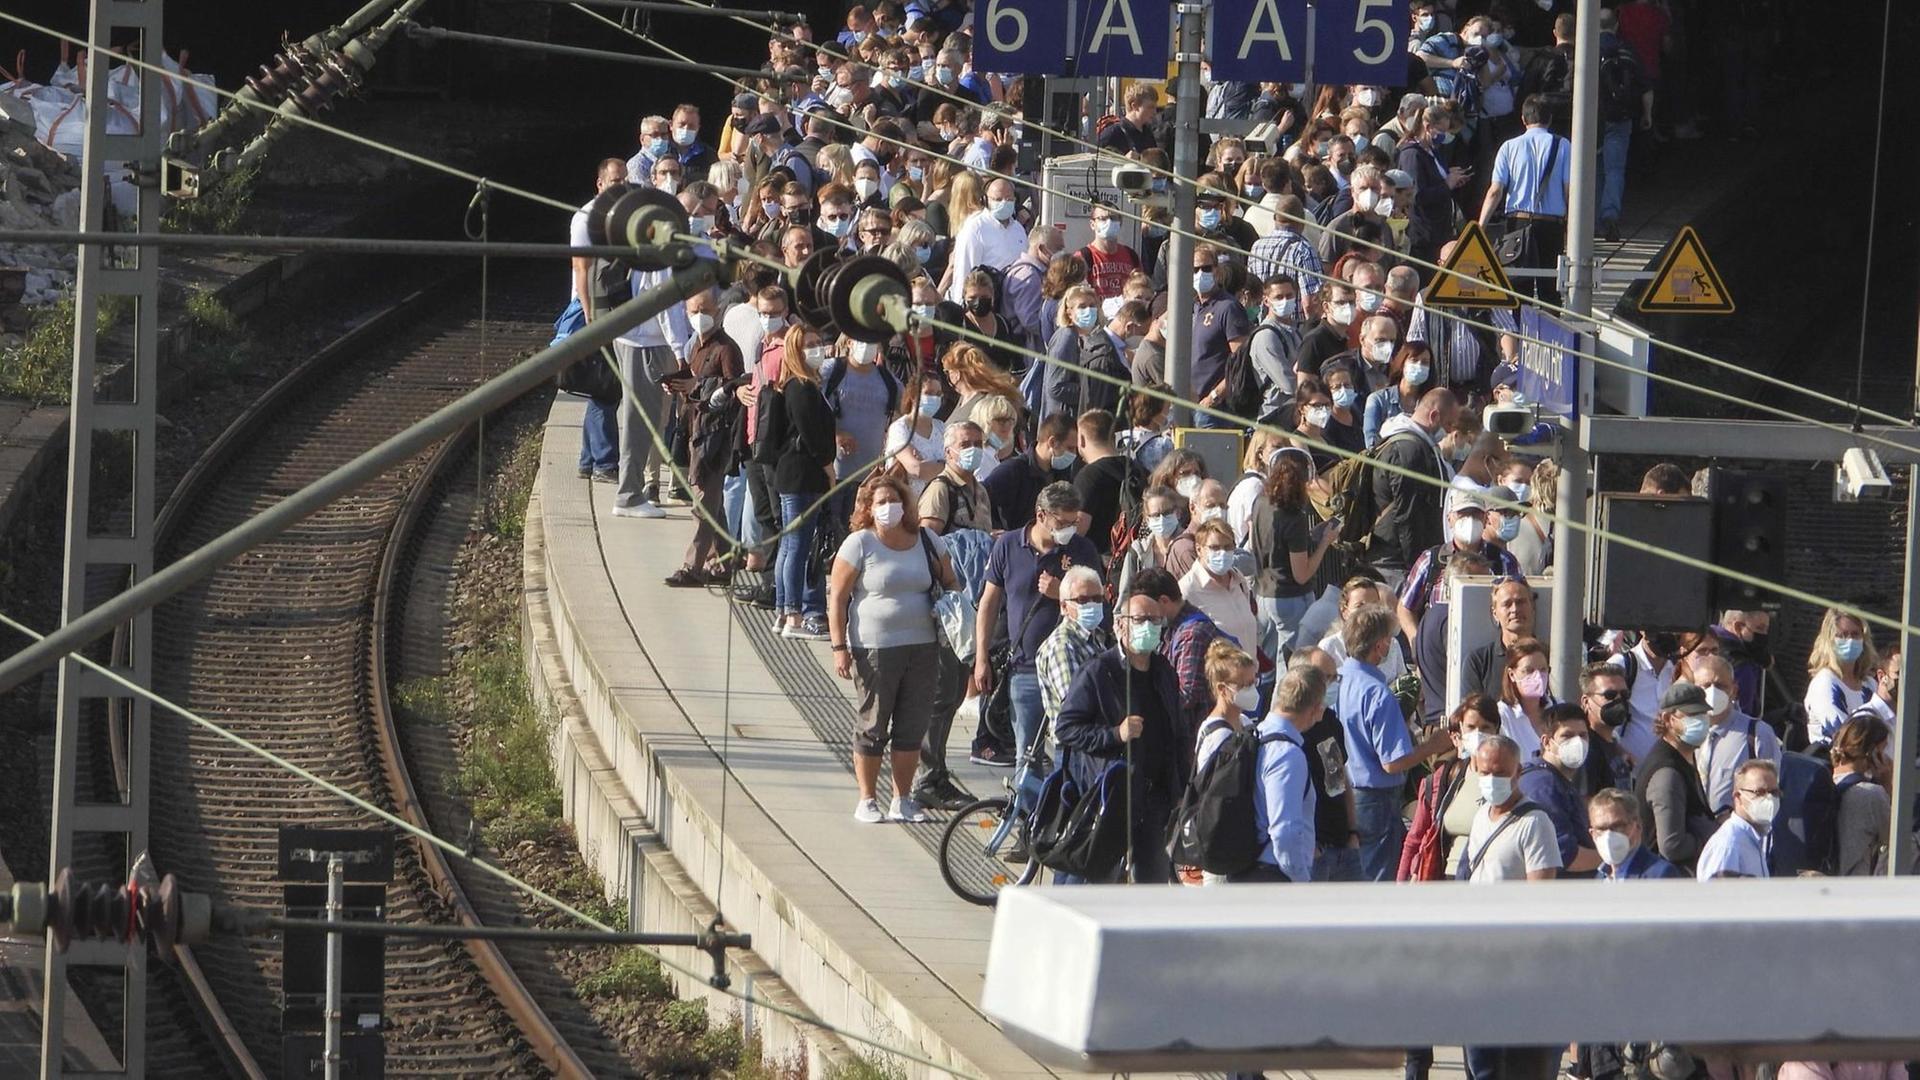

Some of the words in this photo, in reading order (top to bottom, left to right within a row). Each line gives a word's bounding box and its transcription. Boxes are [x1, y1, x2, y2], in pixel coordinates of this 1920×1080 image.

[985, 0, 1029, 52] 6
[1088, 0, 1144, 55] A
[1237, 0, 1293, 61] A
[1353, 0, 1395, 65] 5
